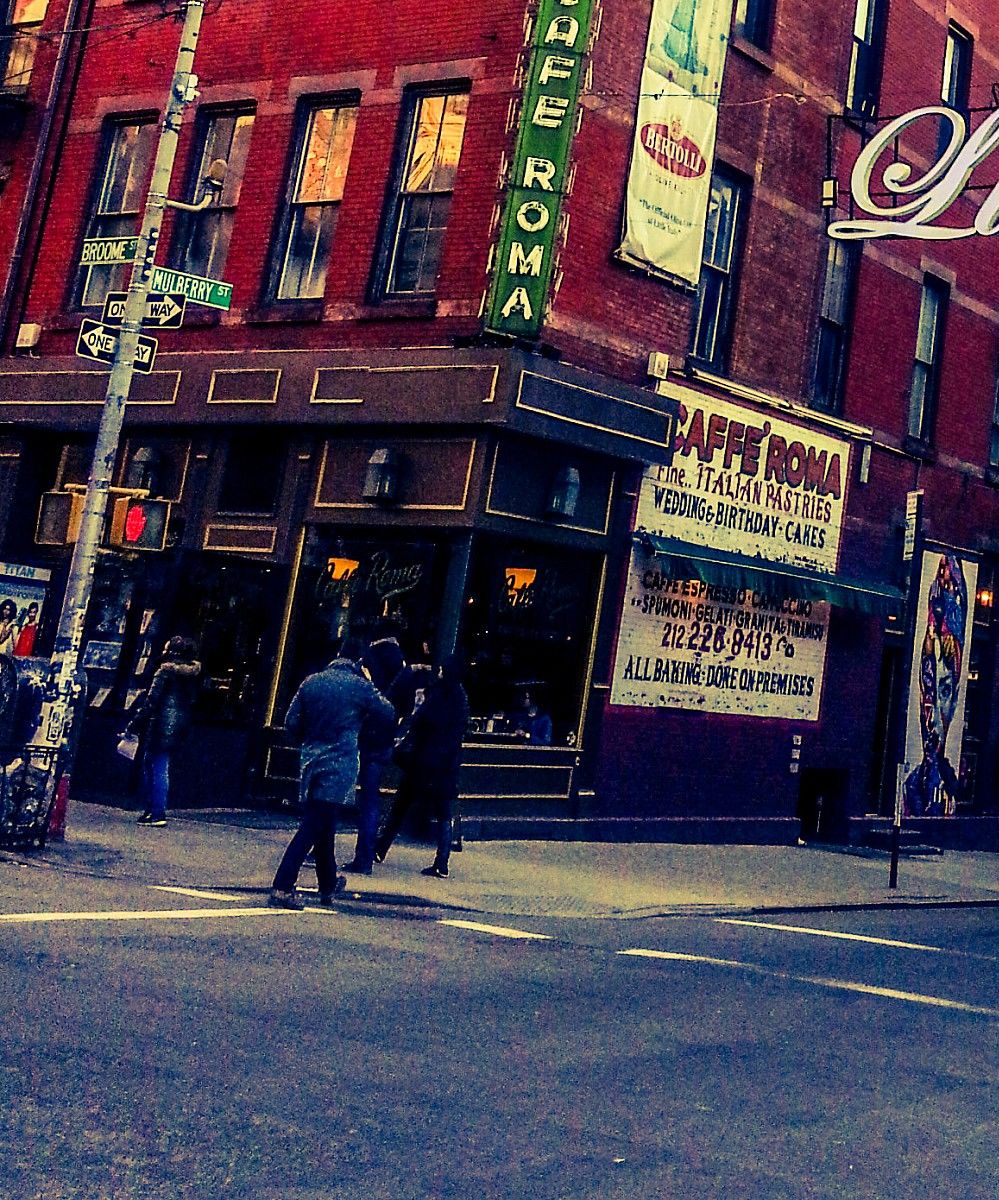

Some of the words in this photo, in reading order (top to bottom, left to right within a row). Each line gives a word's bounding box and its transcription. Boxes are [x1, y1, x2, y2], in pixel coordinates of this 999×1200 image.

[645, 127, 702, 173] BERTOLLI
[81, 241, 128, 261] BROOME
[129, 240, 138, 250] ST
[501, 155, 556, 320] ROMA
[153, 269, 214, 302] MULBERRY
[217, 286, 230, 298] ST
[110, 303, 126, 314] ON
[150, 304, 175, 316] WAY
[88, 333, 112, 350] ONE
[135, 346, 150, 360] AY
[764, 434, 841, 500] ROMA
[696, 463, 762, 505] ITALIAN
[766, 483, 832, 523] PASTRIES
[653, 484, 706, 521] WEDDING
[785, 520, 826, 548] CAKES
[5, 563, 36, 578] TITAN
[642, 594, 692, 620] SPUMONI
[695, 603, 734, 628] GELATI
[623, 654, 652, 682] ALL
[652, 657, 701, 686] BAKING
[705, 664, 739, 689] DONE
[739, 668, 756, 691] ON
[755, 671, 815, 697] PREMISES
